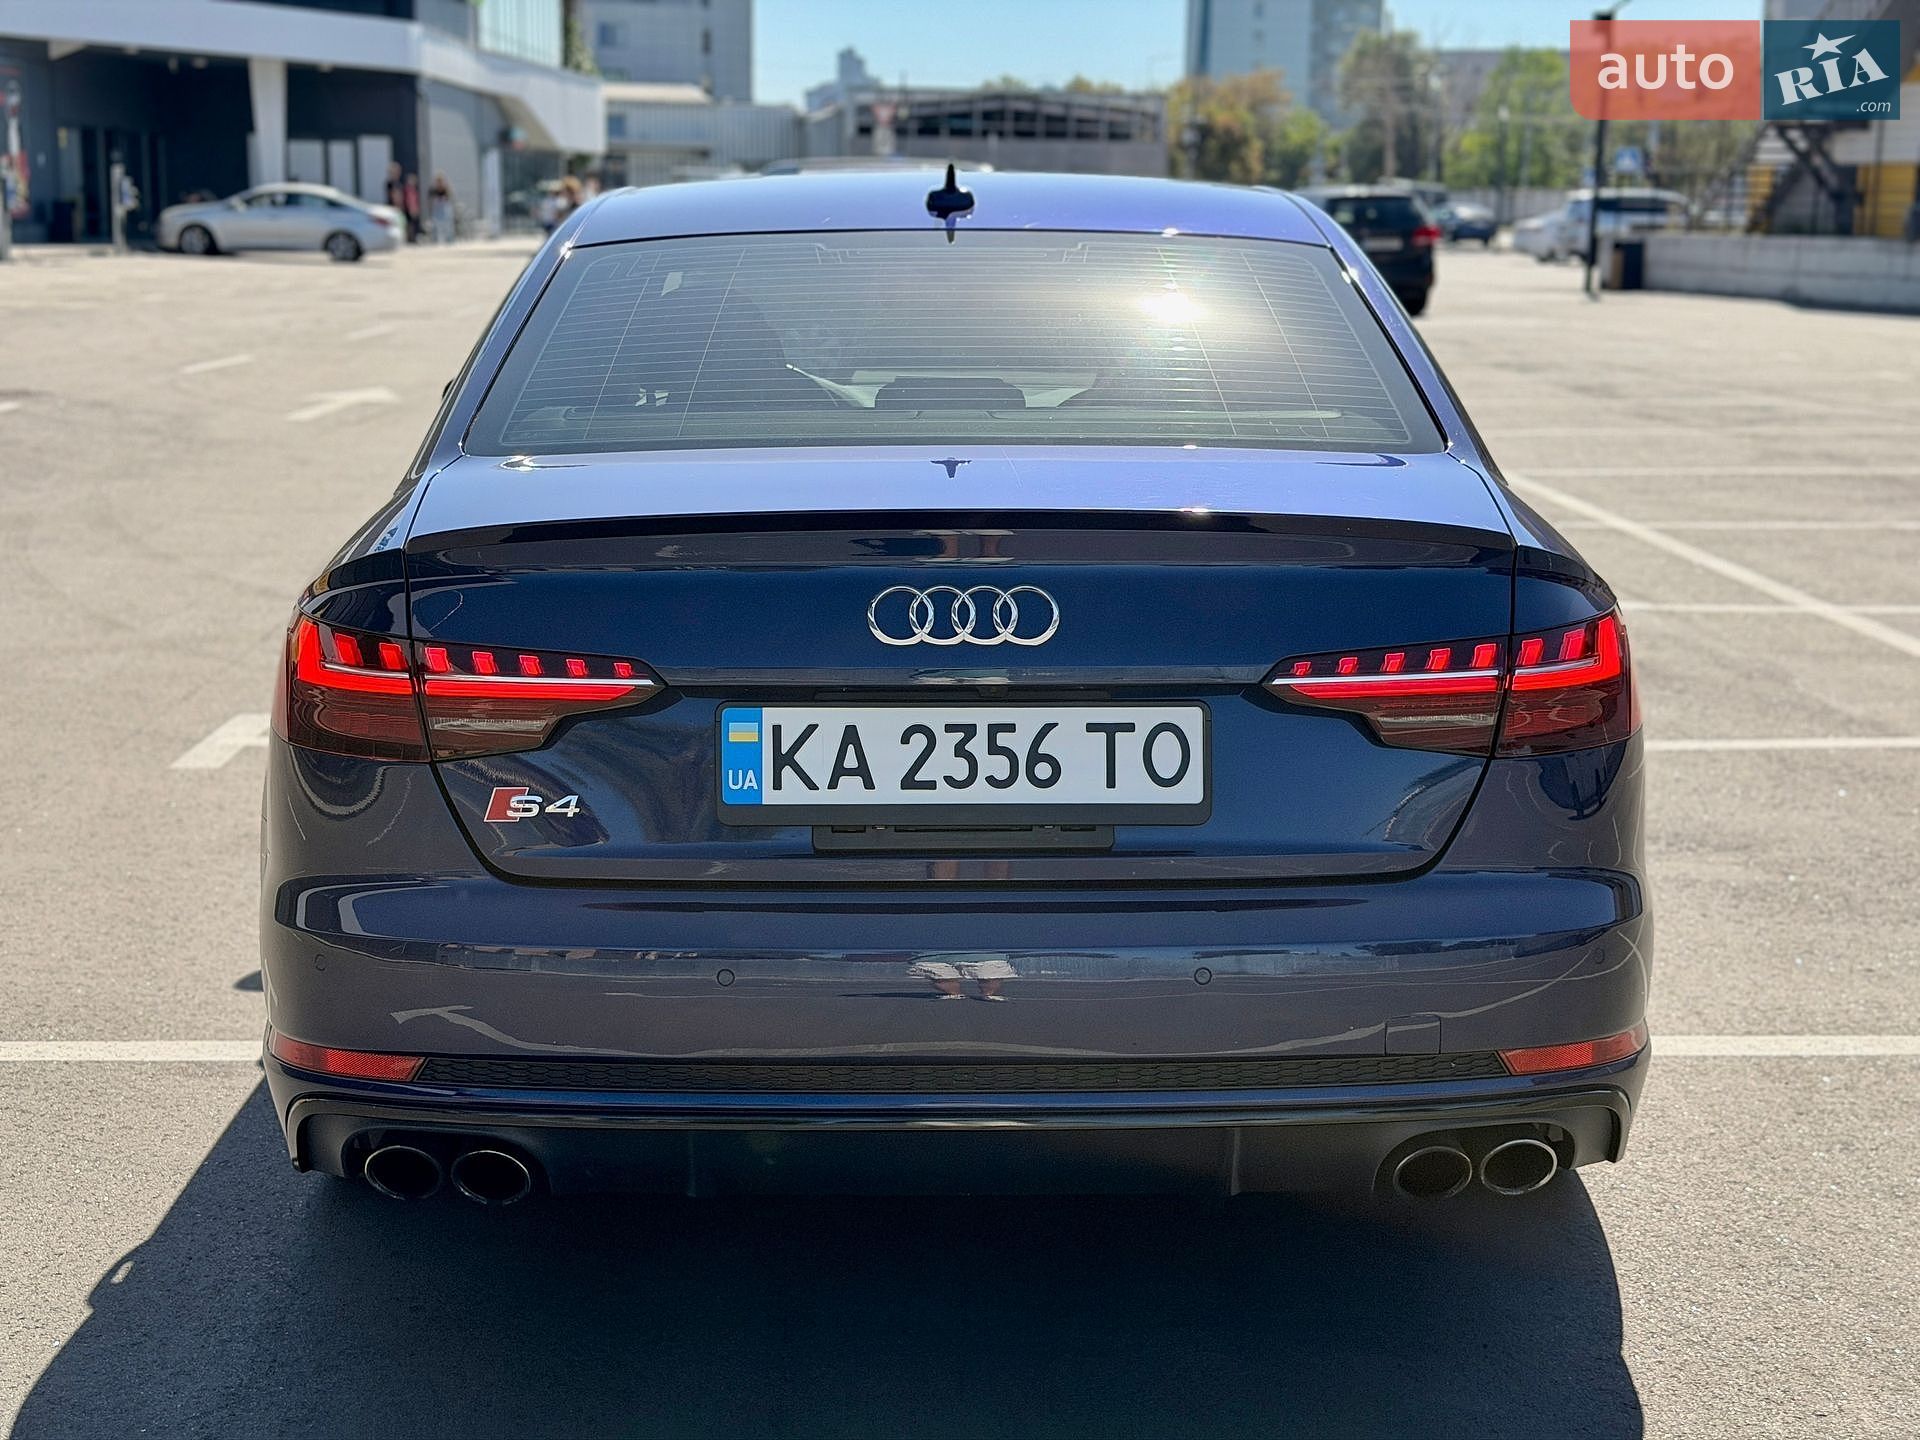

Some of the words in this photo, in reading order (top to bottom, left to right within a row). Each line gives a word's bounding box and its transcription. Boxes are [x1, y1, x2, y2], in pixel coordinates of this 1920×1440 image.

[771, 724, 876, 791] KA
[900, 723, 1062, 791] 2356
[1085, 722, 1192, 789] TO
[728, 769, 758, 790] UA
[506, 795, 580, 818] S4
